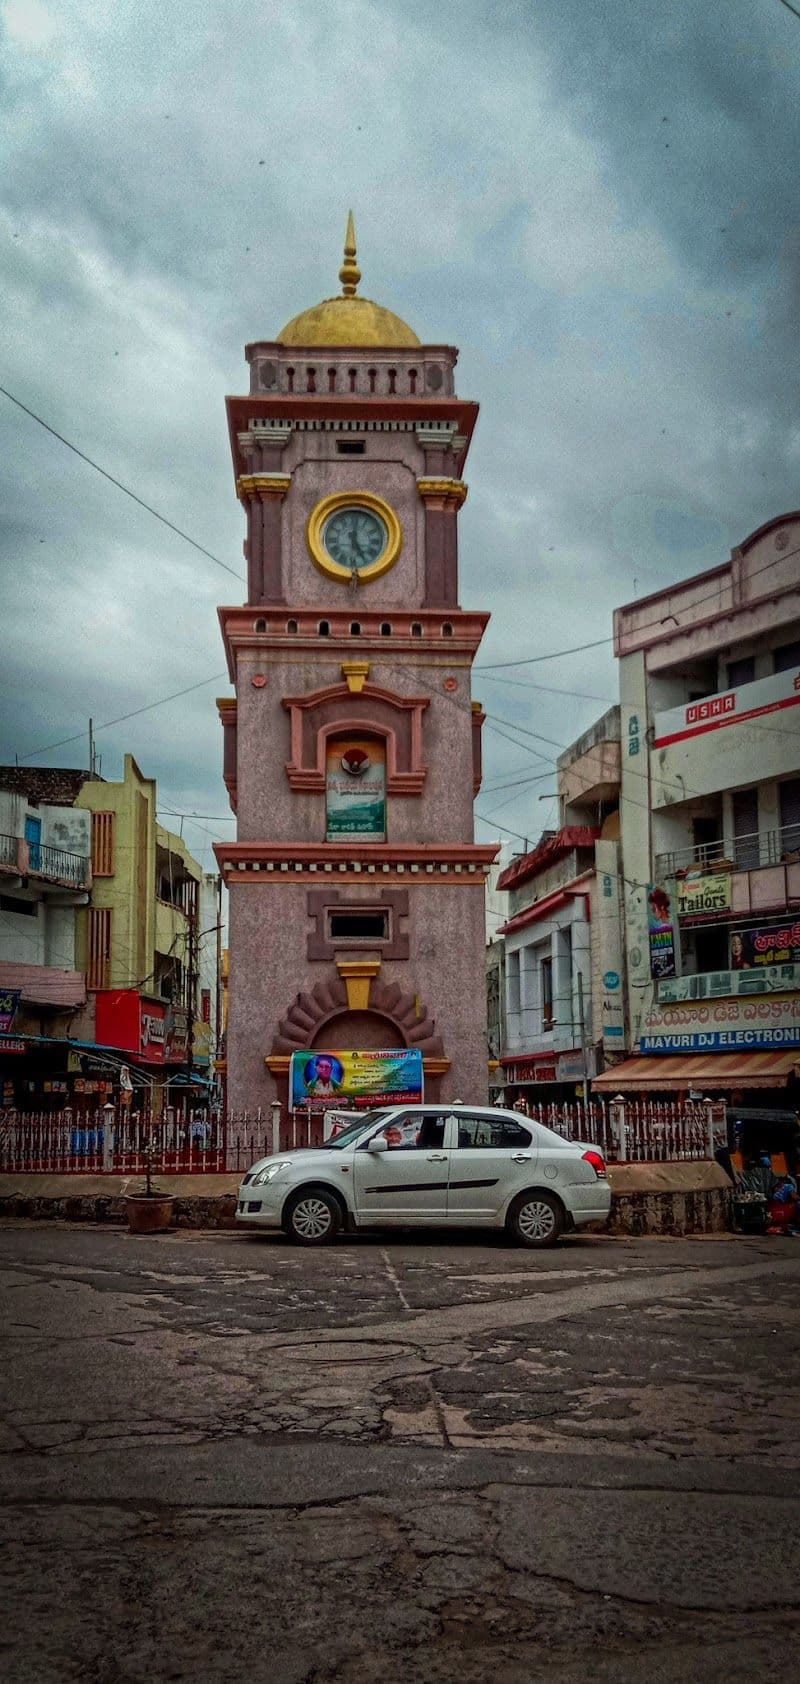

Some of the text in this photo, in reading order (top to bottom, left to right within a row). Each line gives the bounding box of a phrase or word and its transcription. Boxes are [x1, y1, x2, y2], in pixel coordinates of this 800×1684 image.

[688, 697, 733, 721] USHA
[678, 894, 726, 912] Tailors
[644, 1028, 800, 1049] MAYURI DJ ELECTRONI
